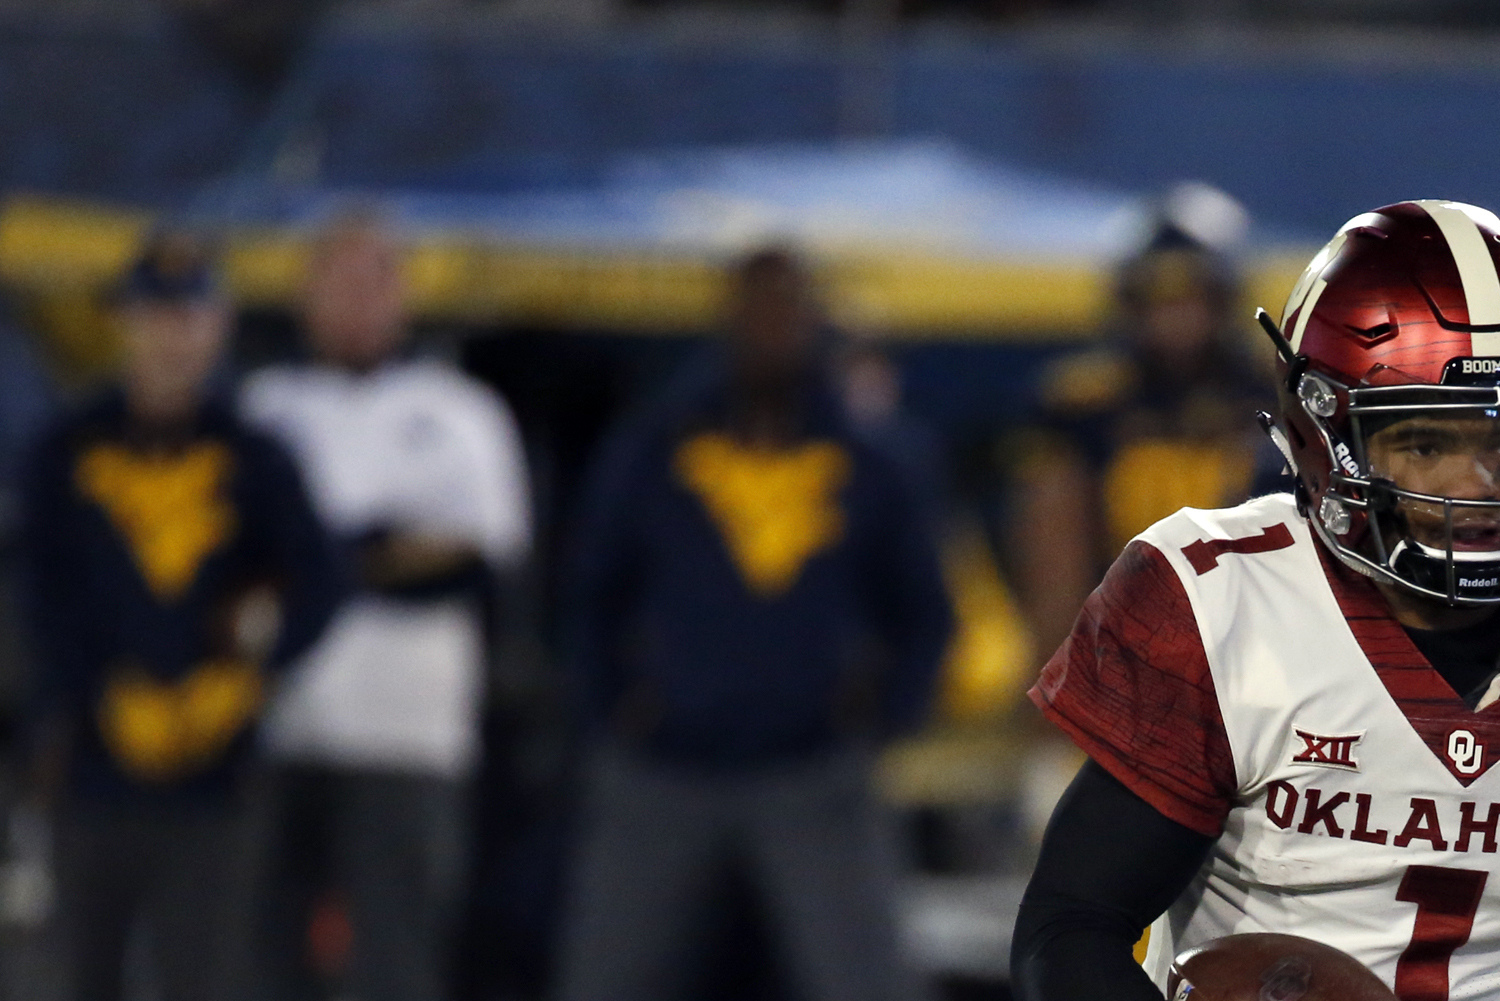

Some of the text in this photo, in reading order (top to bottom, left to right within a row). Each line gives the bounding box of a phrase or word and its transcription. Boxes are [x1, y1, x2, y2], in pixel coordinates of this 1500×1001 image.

[1180, 522, 1295, 576] 1
[1459, 578, 1498, 587] Riddell
[1292, 729, 1362, 769] XII
[1448, 729, 1484, 774] OU
